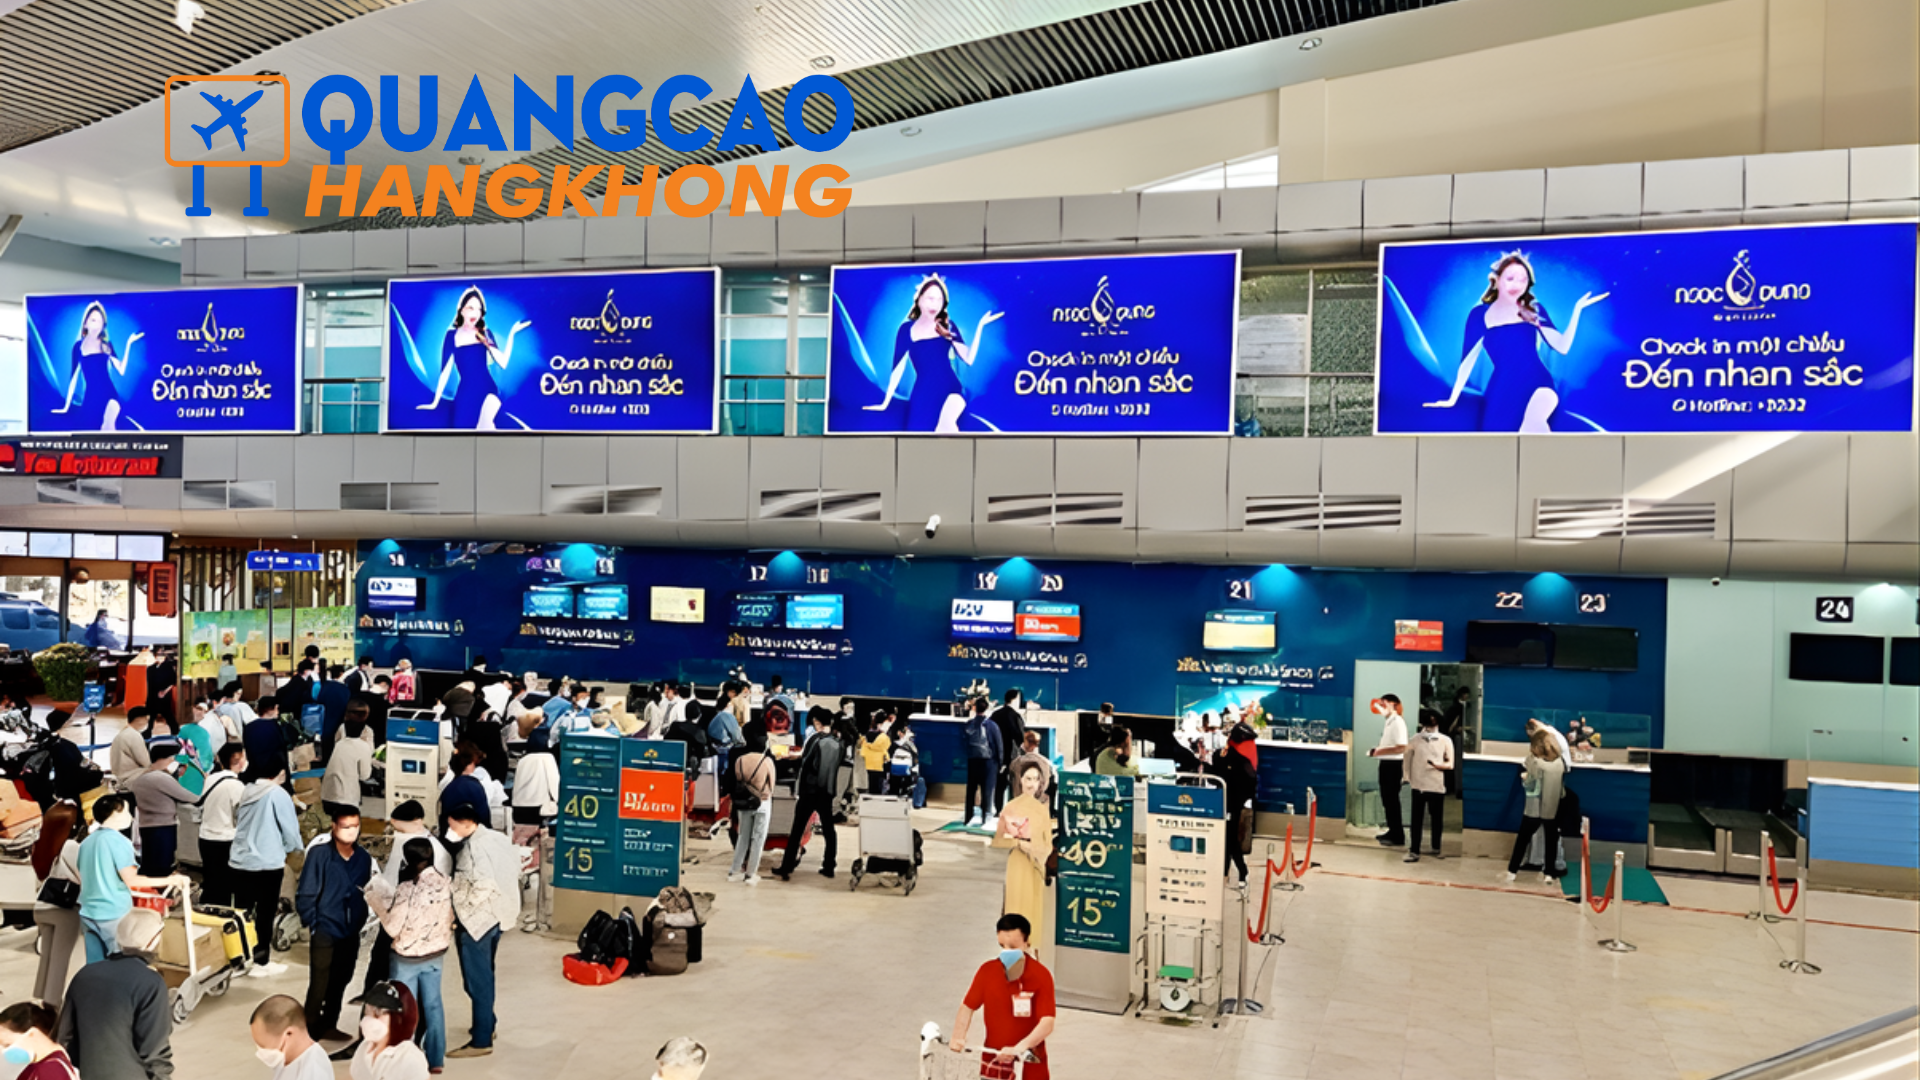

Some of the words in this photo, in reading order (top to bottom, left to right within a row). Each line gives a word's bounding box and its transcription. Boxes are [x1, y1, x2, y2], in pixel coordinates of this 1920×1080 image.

[1705, 358, 1792, 387] nhan
[1229, 580, 1252, 599] 21
[1495, 592, 1524, 609] 22
[1820, 599, 1850, 619] 24
[564, 794, 599, 819] 40
[564, 846, 593, 872] 15
[1067, 896, 1102, 926] 15
